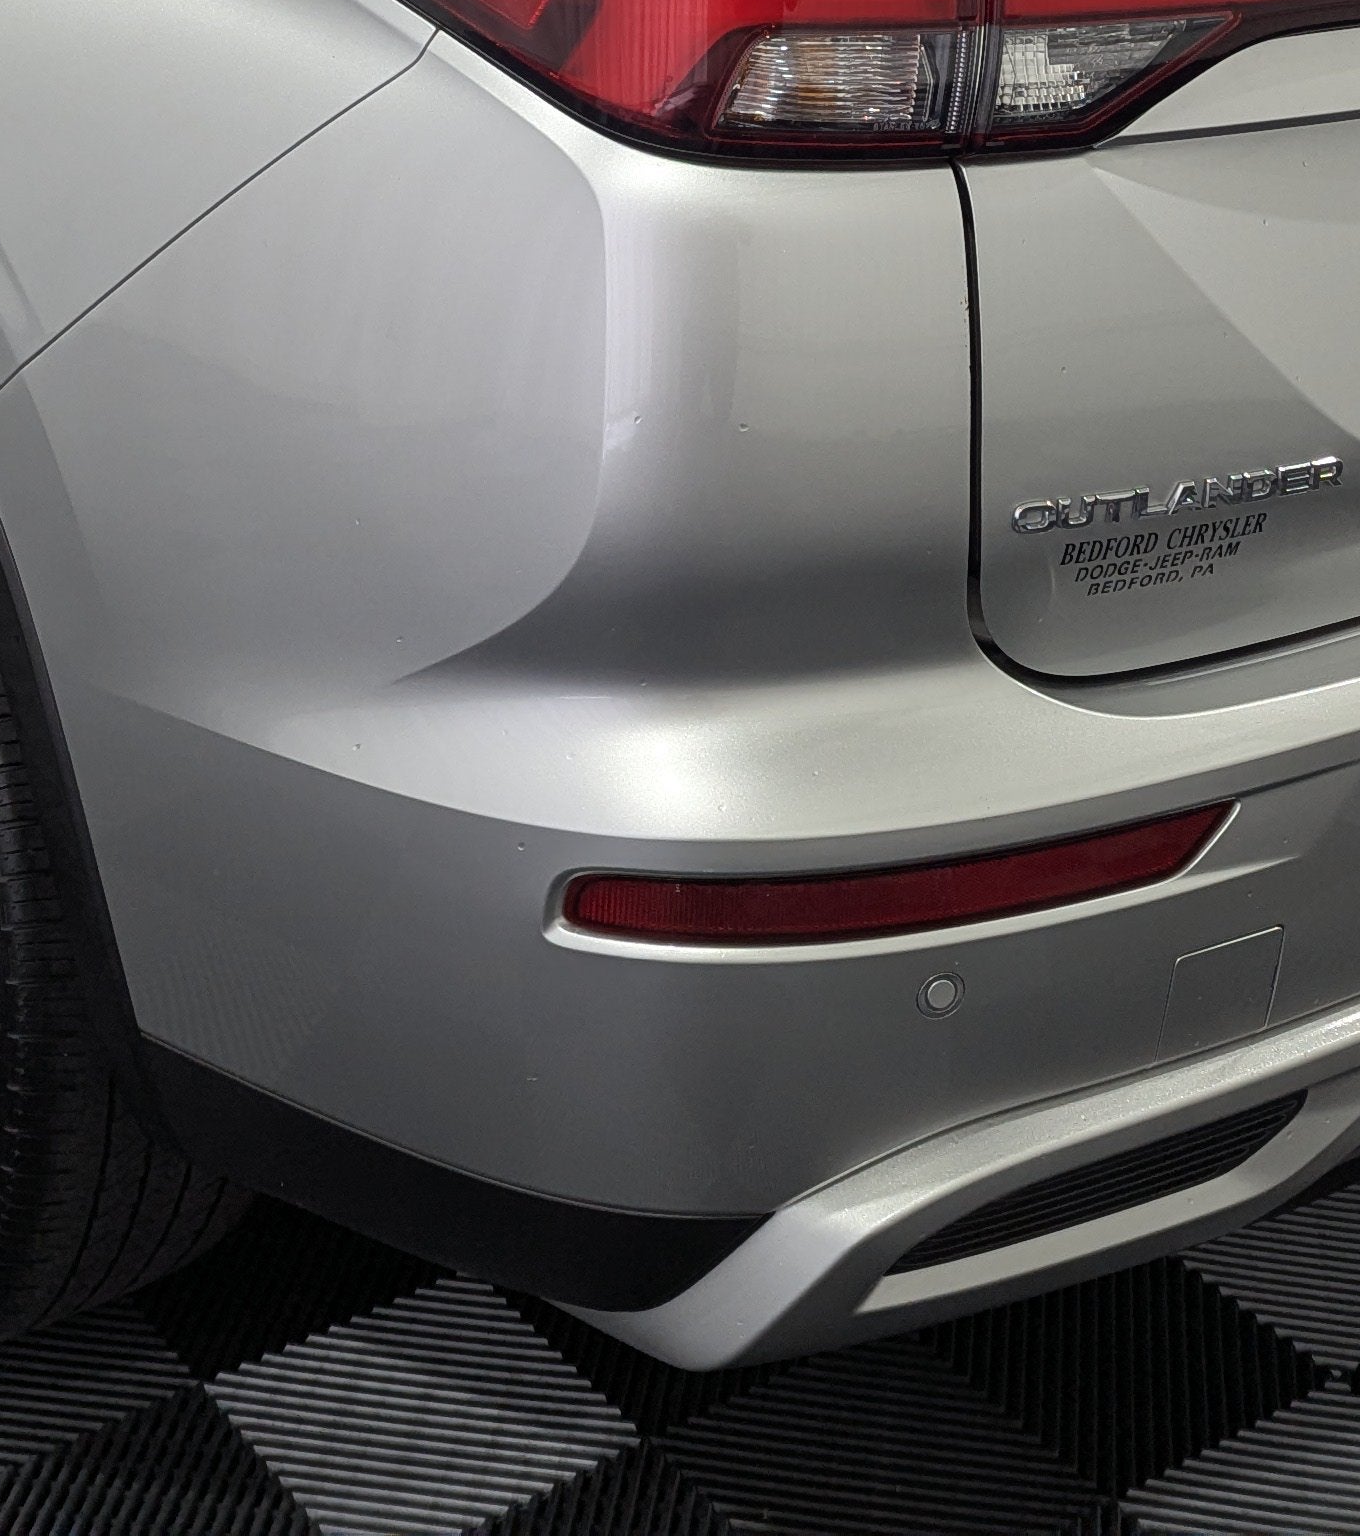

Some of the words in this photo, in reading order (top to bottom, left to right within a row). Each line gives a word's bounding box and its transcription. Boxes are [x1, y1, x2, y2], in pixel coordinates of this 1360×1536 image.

[1011, 455, 1344, 534] OUTLANDER
[1060, 532, 1159, 566] BEDFORD
[1166, 513, 1267, 551] CHRYSLER
[1087, 567, 1184, 596] BEDFORD,
[1191, 563, 1215, 578] PA
